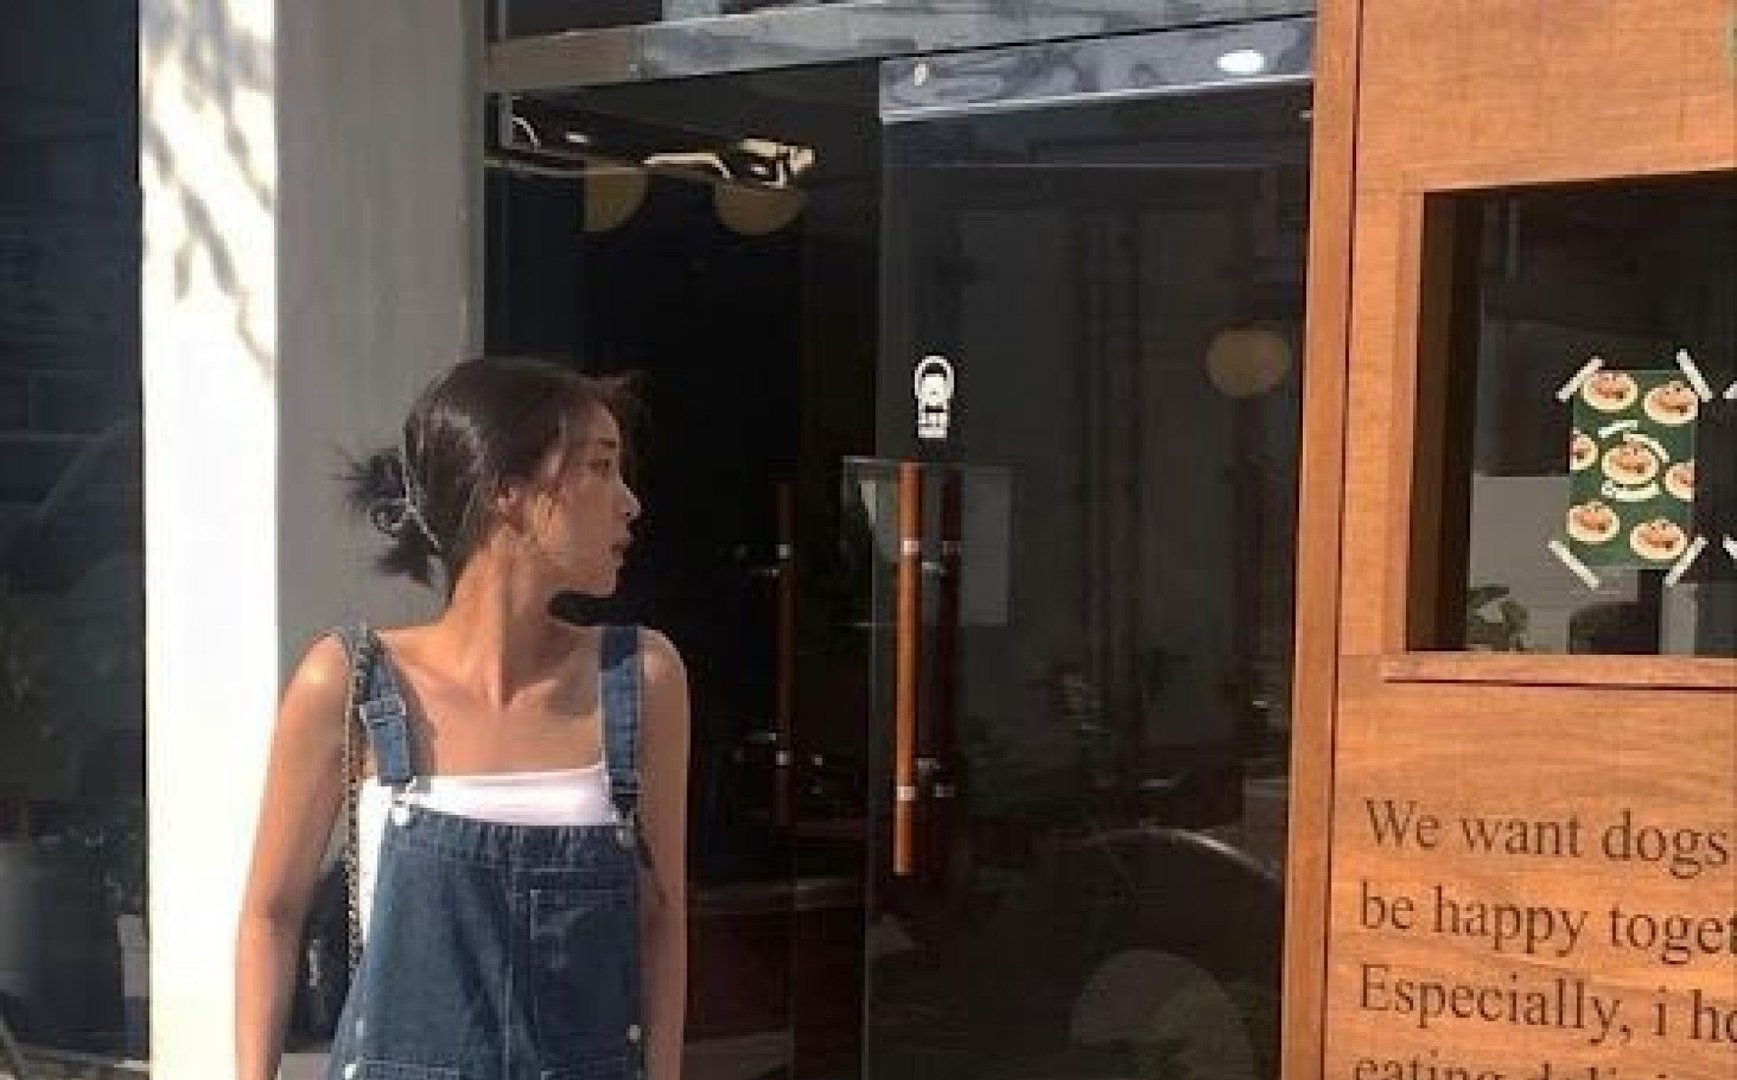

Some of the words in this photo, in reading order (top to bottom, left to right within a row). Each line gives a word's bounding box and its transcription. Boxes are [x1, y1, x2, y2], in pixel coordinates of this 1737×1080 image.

[1363, 797, 1441, 848] We
[1459, 811, 1583, 858] want
[1602, 808, 1728, 880] dogs
[1359, 879, 1415, 930] be
[1433, 884, 1588, 958] happy
[1359, 962, 1632, 1044] Especially,
[1652, 986, 1667, 1037] i
